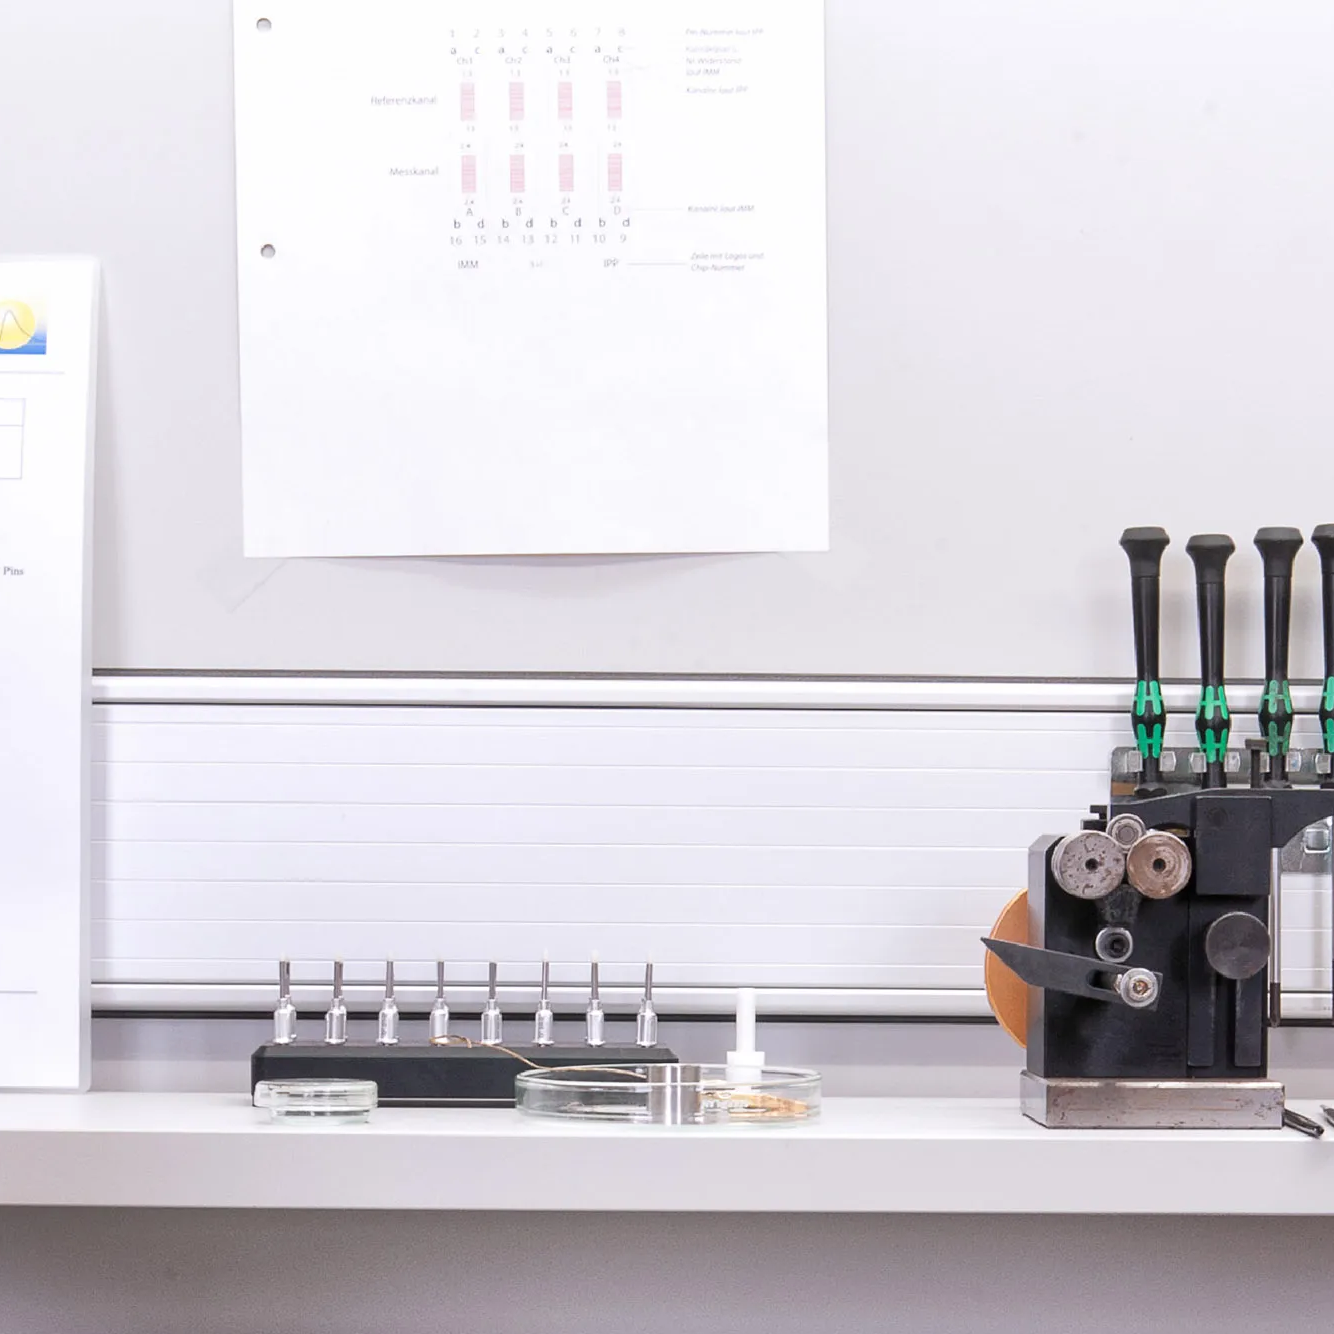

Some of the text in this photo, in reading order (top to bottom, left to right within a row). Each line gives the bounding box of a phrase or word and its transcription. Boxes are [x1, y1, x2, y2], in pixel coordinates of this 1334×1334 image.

[371, 96, 437, 106] Referenzkanal
[389, 166, 439, 176] Messkanal
[3, 566, 24, 576] Pins
